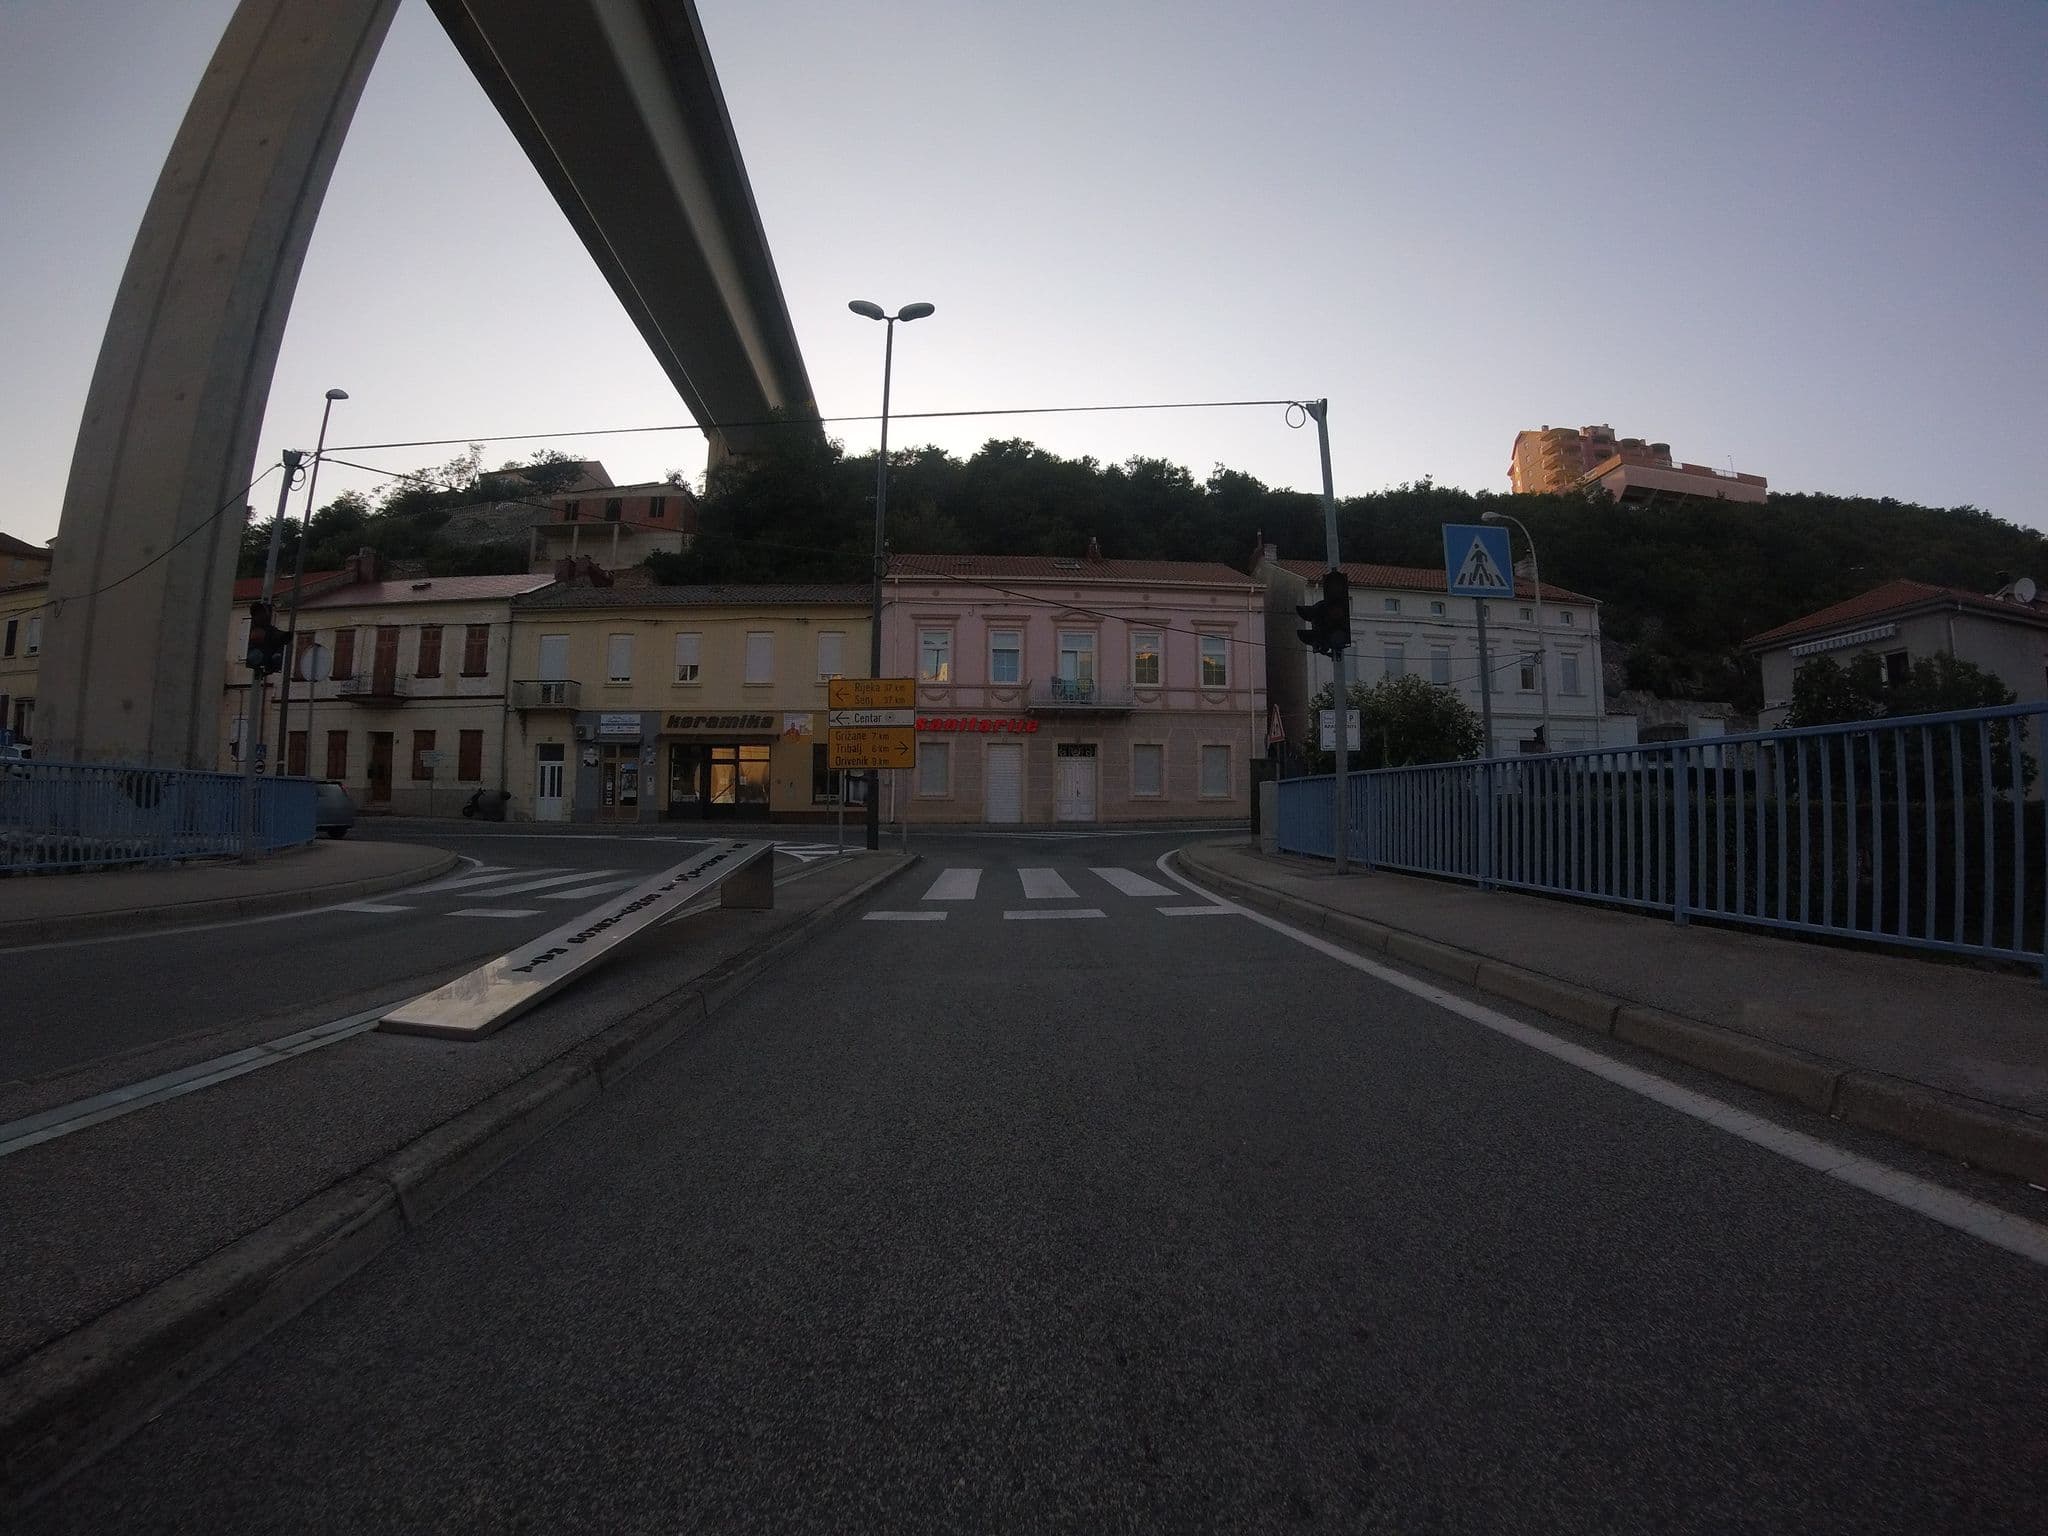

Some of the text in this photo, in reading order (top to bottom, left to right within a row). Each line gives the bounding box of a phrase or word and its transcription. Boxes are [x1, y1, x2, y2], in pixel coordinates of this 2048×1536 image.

[854, 682, 880, 694] Rijeka
[854, 695, 873, 706] Senj
[667, 714, 775, 729] keramika
[854, 713, 882, 723] Centar
[915, 716, 1039, 734] sanitarije
[871, 732, 877, 741] 7
[879, 733, 890, 741] km
[835, 743, 862, 755] Tribalj
[879, 744, 890, 753] km
[835, 756, 868, 766] Drivenik
[879, 757, 890, 766] km
